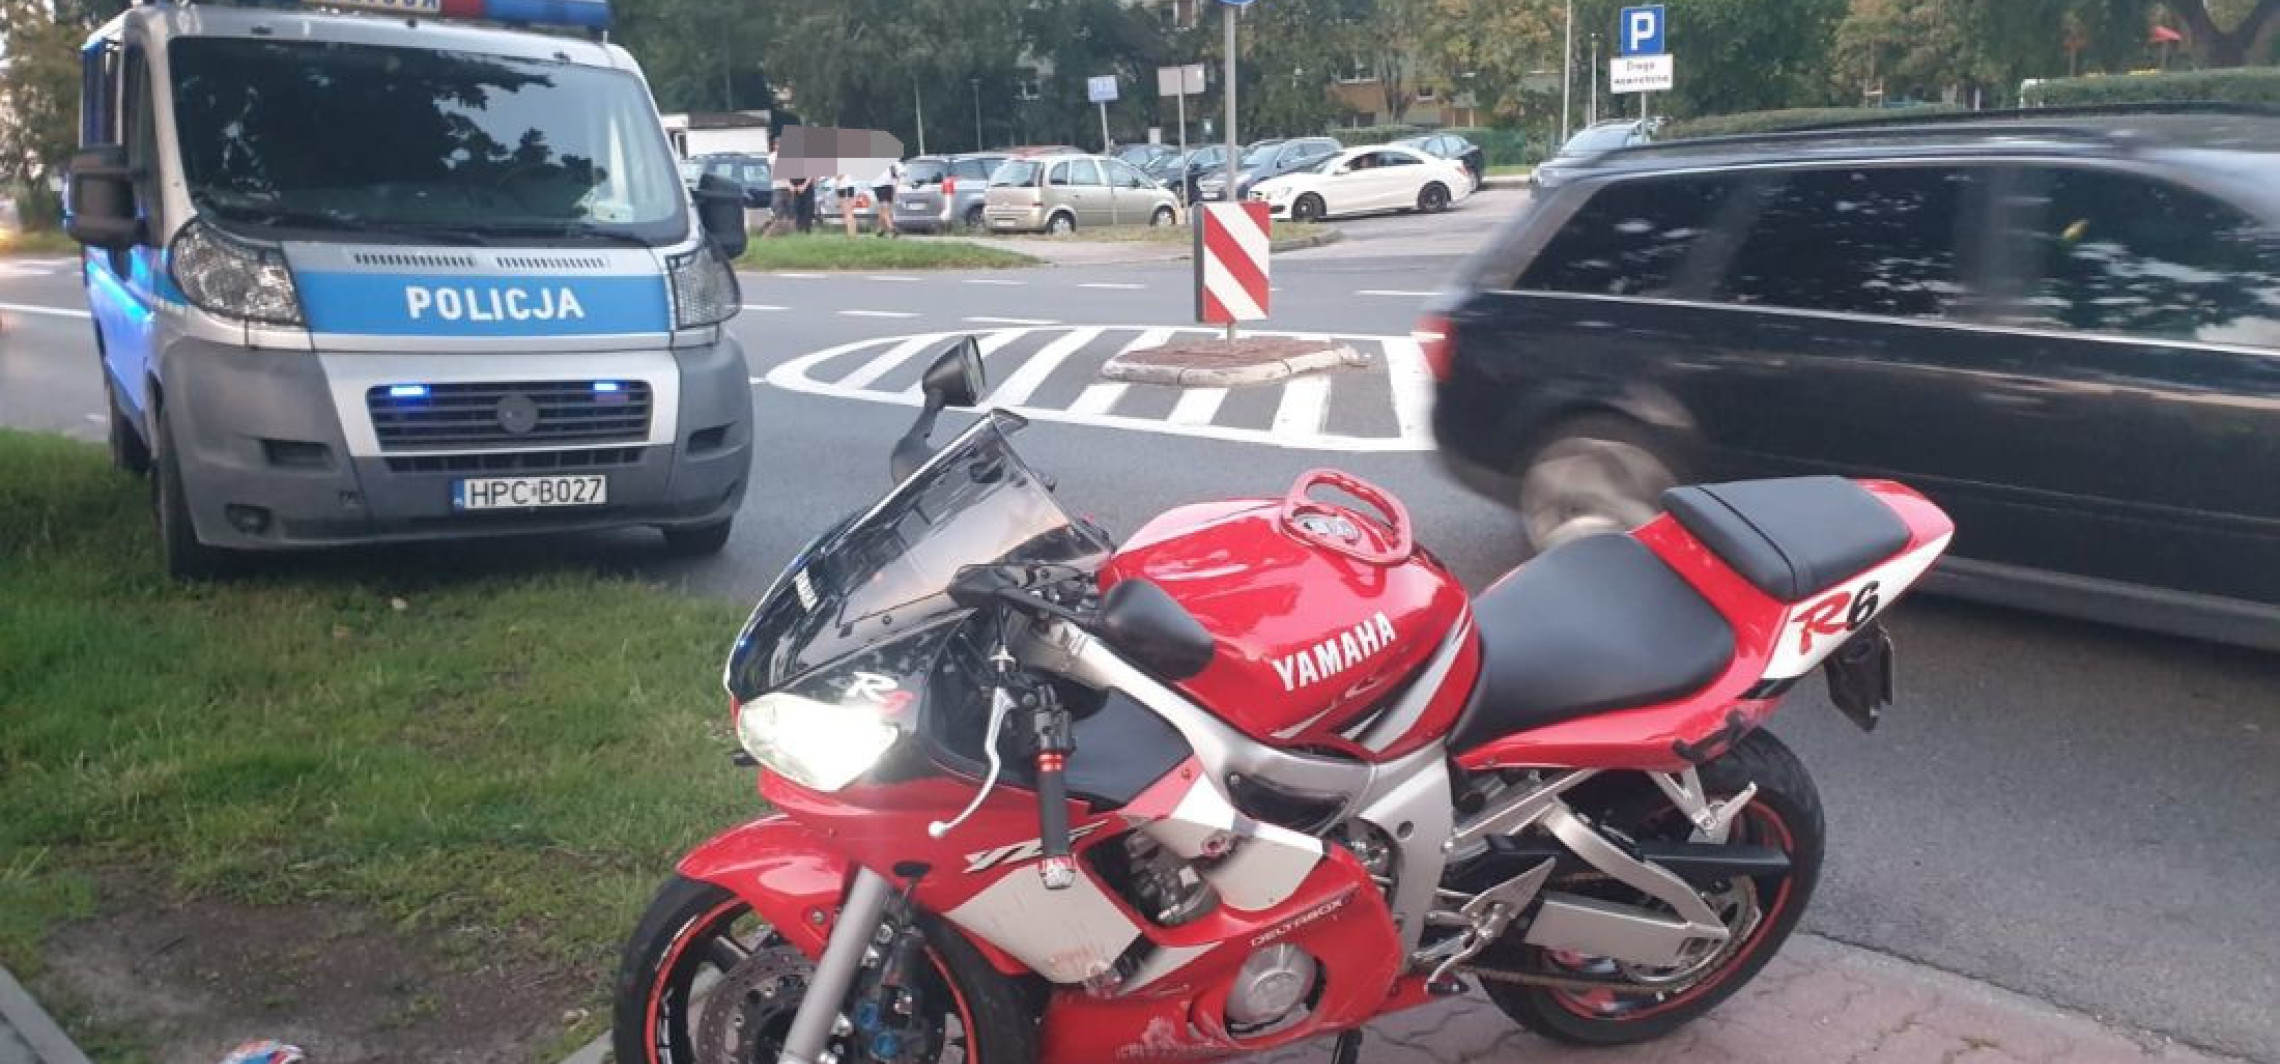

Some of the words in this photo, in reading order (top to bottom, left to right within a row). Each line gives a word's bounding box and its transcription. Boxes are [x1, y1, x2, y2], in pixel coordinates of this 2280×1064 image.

[1630, 12, 1655, 51] P
[405, 285, 586, 321] POLICJA
[1790, 580, 1880, 655] R6
[1272, 611, 1396, 692] YAMAHA
